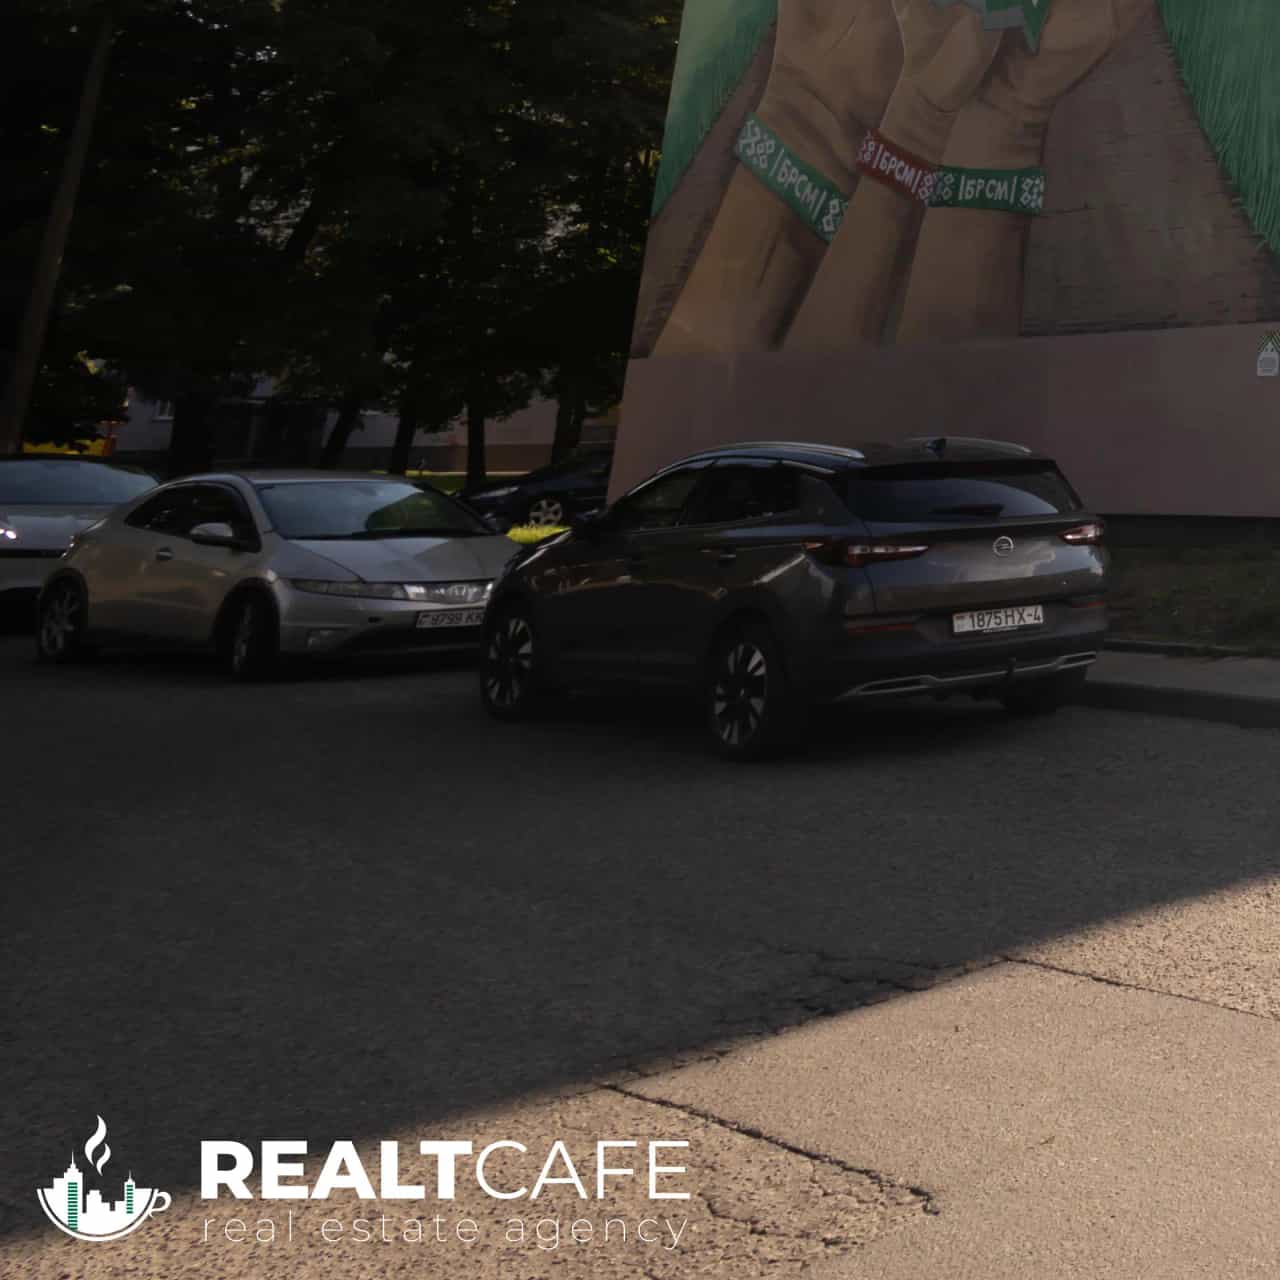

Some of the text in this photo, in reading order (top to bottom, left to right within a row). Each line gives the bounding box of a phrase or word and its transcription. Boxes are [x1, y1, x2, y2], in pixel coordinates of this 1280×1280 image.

[774, 158, 819, 210] БРСМ
[878, 152, 915, 188] БРСМ
[966, 179, 1010, 201] БРСМ
